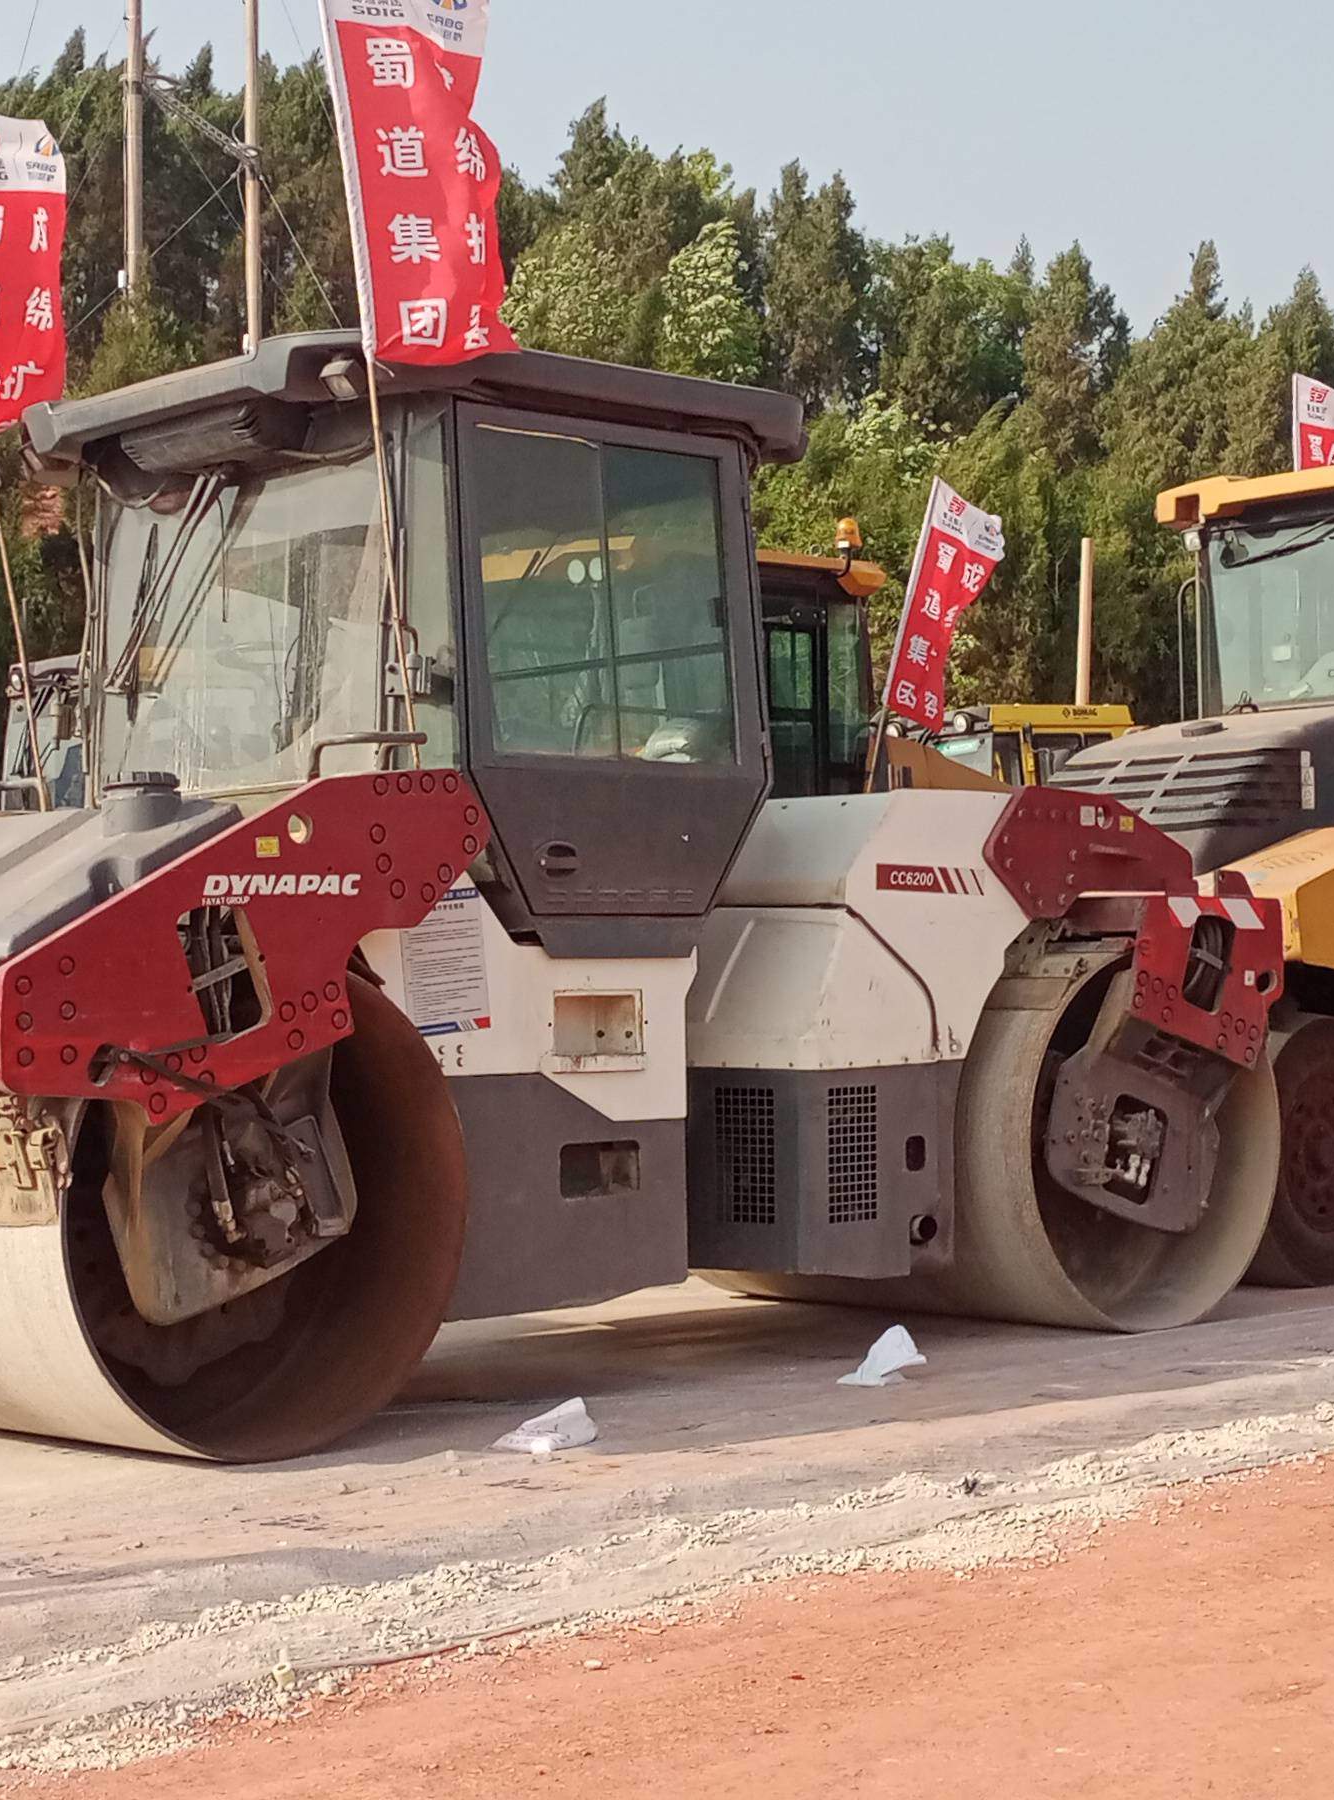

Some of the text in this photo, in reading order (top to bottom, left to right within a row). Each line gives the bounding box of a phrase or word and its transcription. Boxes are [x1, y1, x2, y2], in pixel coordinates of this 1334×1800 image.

[352, 5, 405, 18] SDIG
[365, 37, 449, 348] 蜀道集团
[202, 873, 361, 896] DYNAPAC
[889, 871, 935, 886] CC6200
[201, 895, 251, 906] FAYAT GROUP
